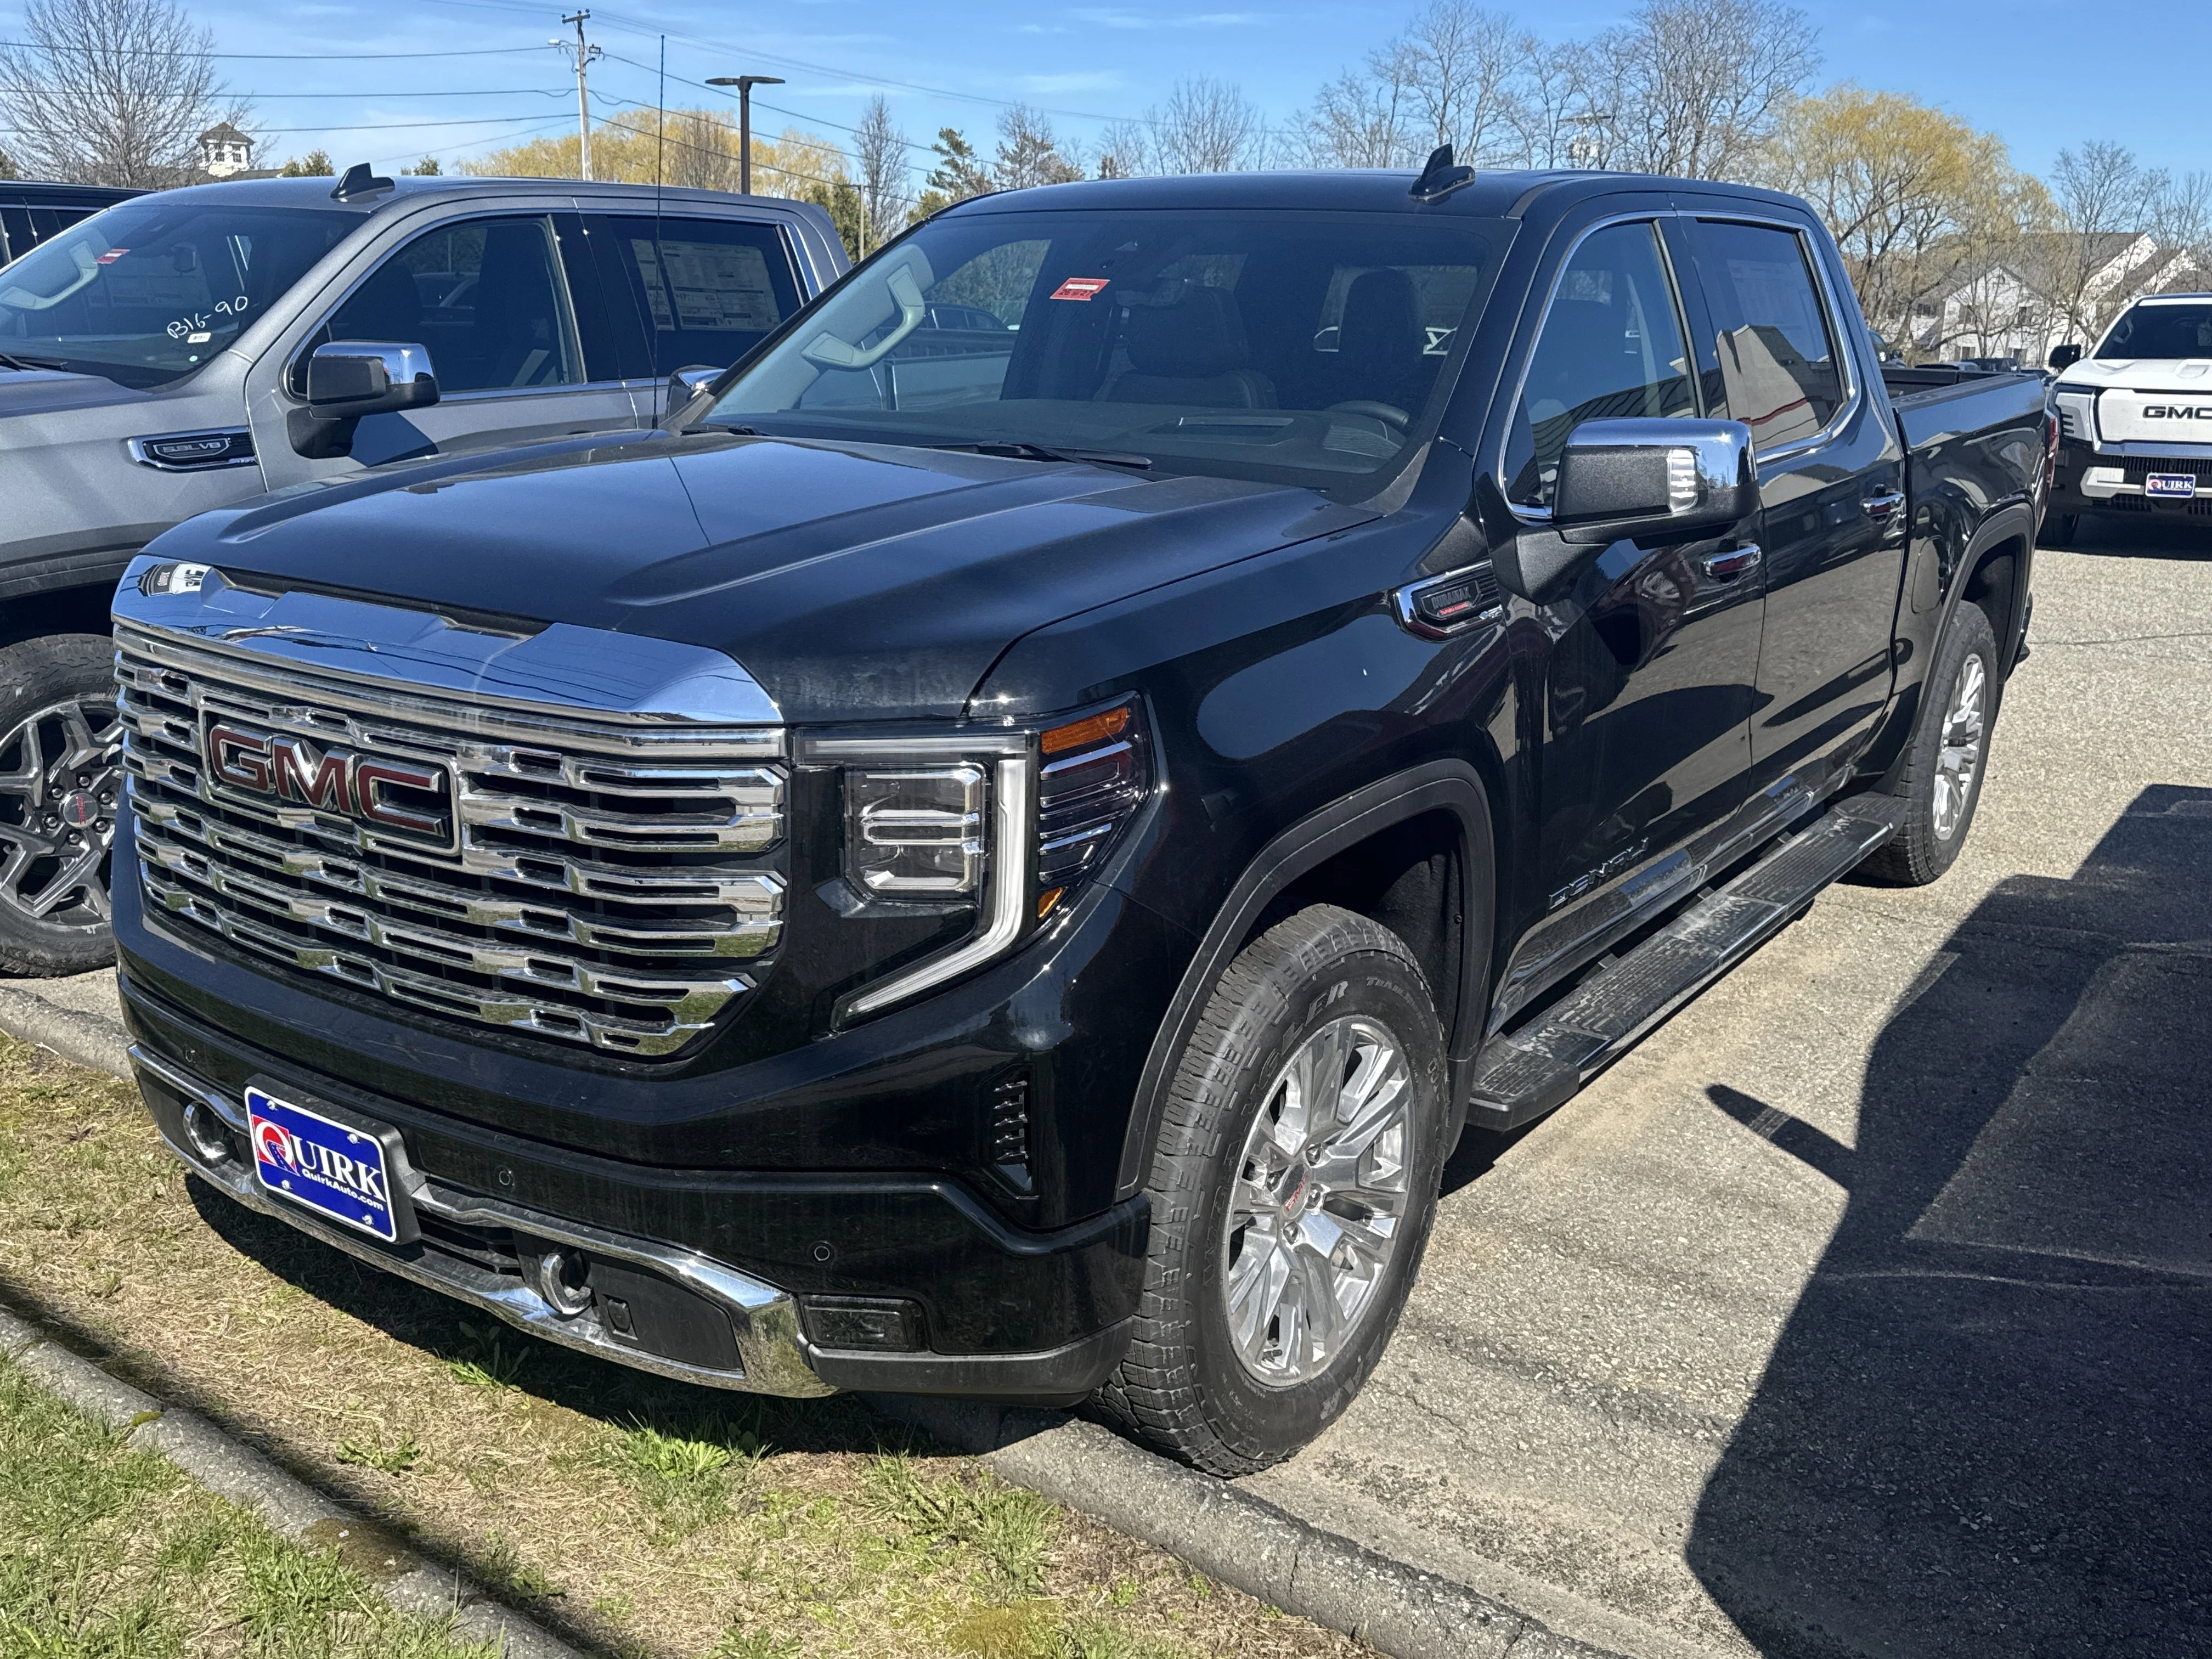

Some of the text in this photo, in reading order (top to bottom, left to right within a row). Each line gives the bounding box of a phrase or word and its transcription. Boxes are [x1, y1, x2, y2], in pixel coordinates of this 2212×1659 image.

[167, 296, 248, 339] B16-90
[2142, 405, 2212, 420] GMC
[2148, 479, 2192, 490] QUIRK
[210, 722, 445, 837] GMC
[254, 1121, 387, 1203] QUIRK
[301, 1168, 384, 1212] QuirkAuto.com
